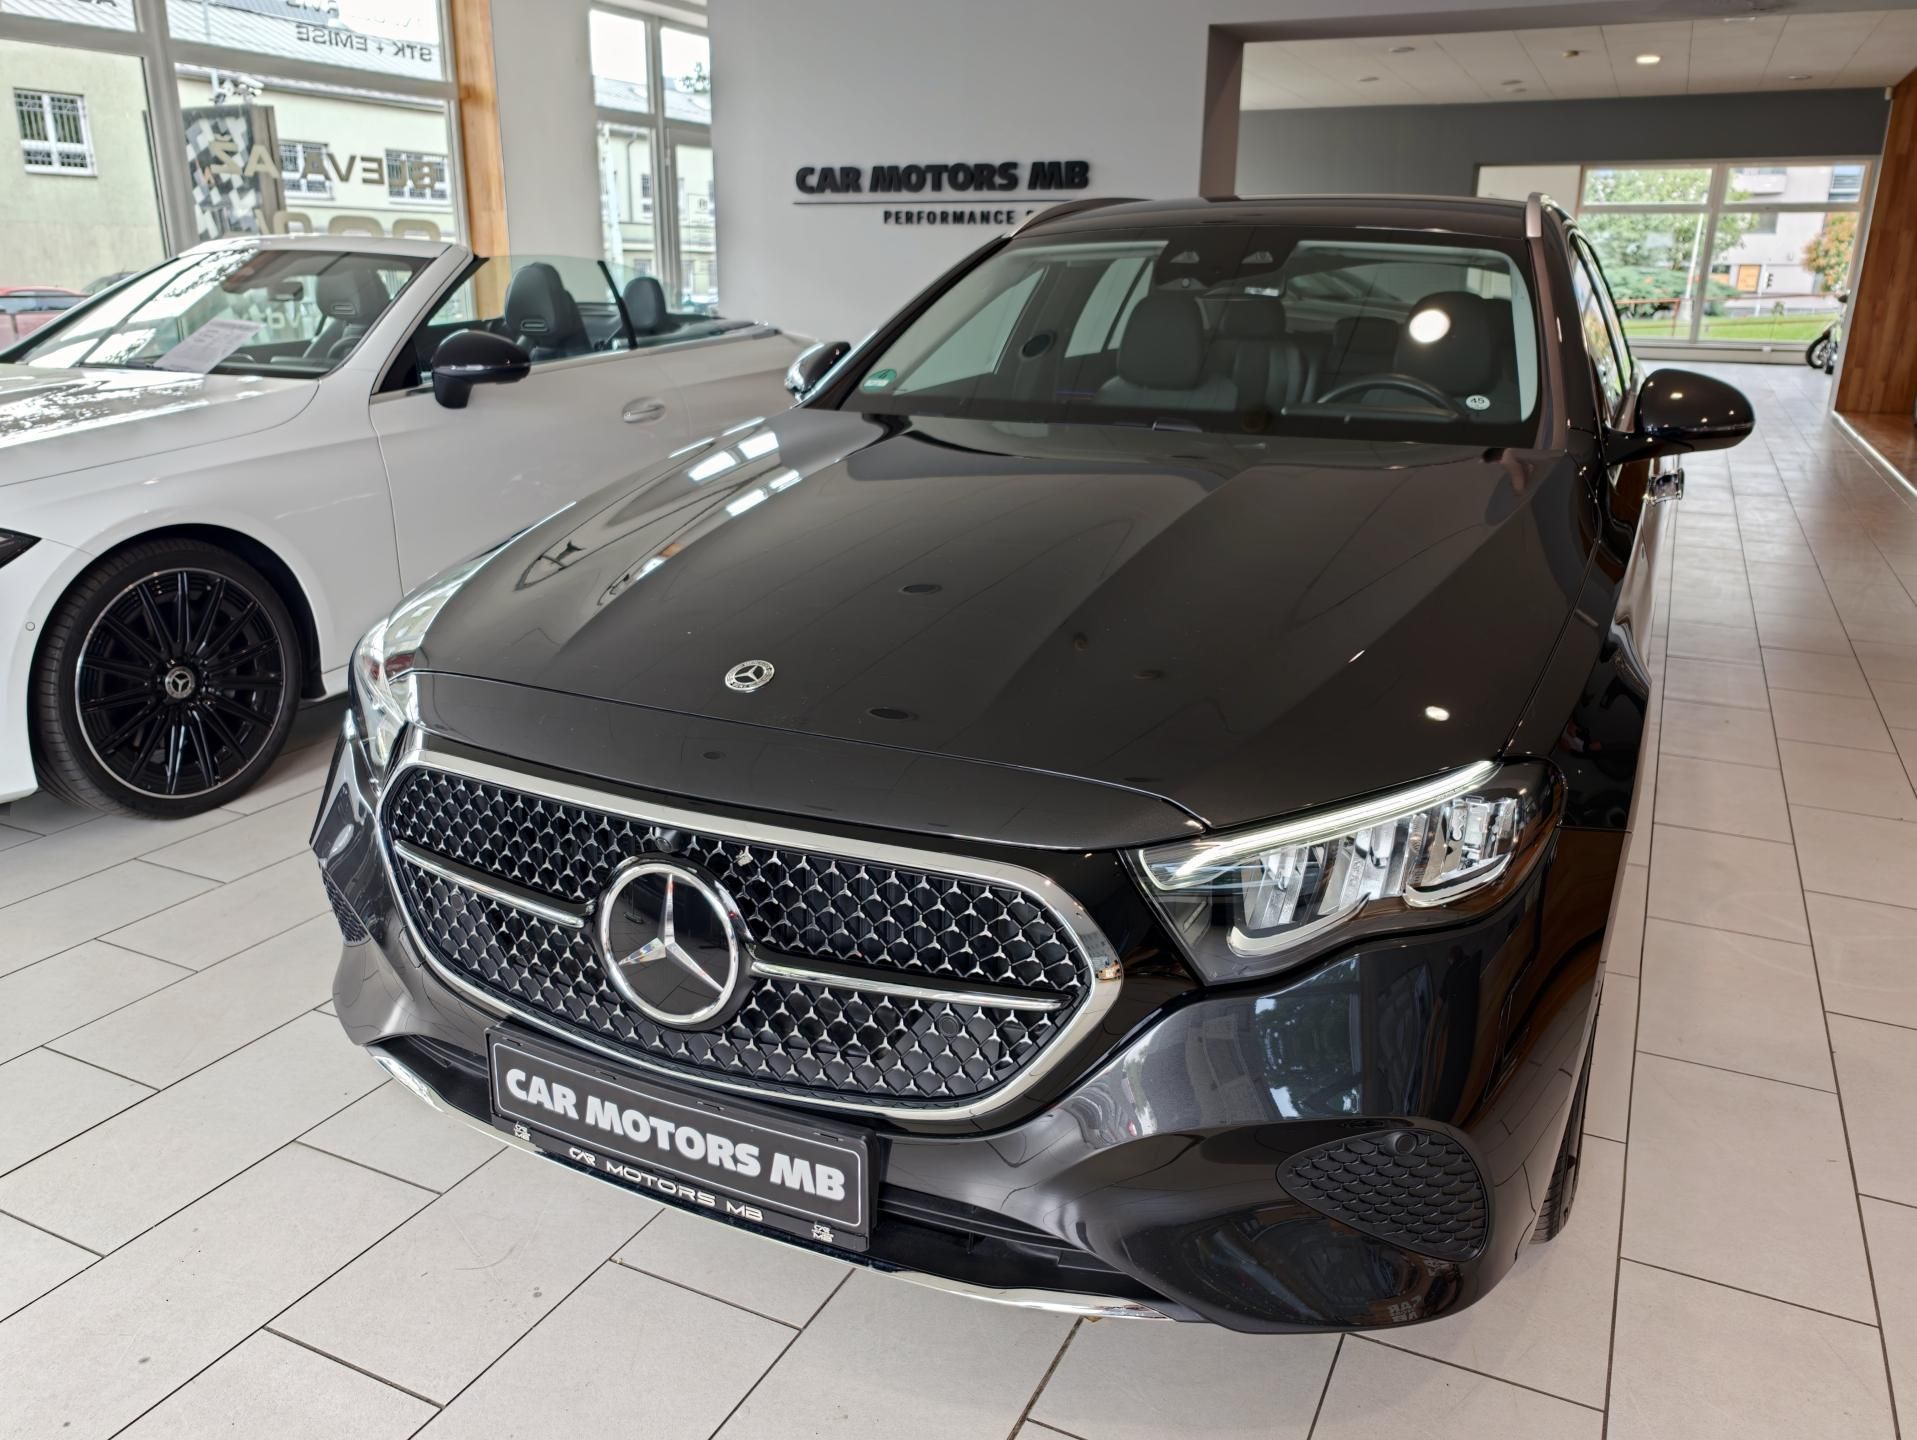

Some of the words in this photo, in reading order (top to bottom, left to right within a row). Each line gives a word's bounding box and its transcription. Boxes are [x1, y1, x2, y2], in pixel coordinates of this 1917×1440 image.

[795, 166, 862, 194] CAR
[869, 161, 1018, 193] MOTORS
[1027, 160, 1090, 190] MB
[883, 209, 1016, 225] PERFORMANCE
[506, 1068, 580, 1120] CAR
[585, 1095, 761, 1178] MOTORS
[769, 1152, 845, 1201] MB
[569, 1147, 597, 1166] CAR
[606, 1160, 716, 1208] MOTORS
[726, 1200, 764, 1223] MB
